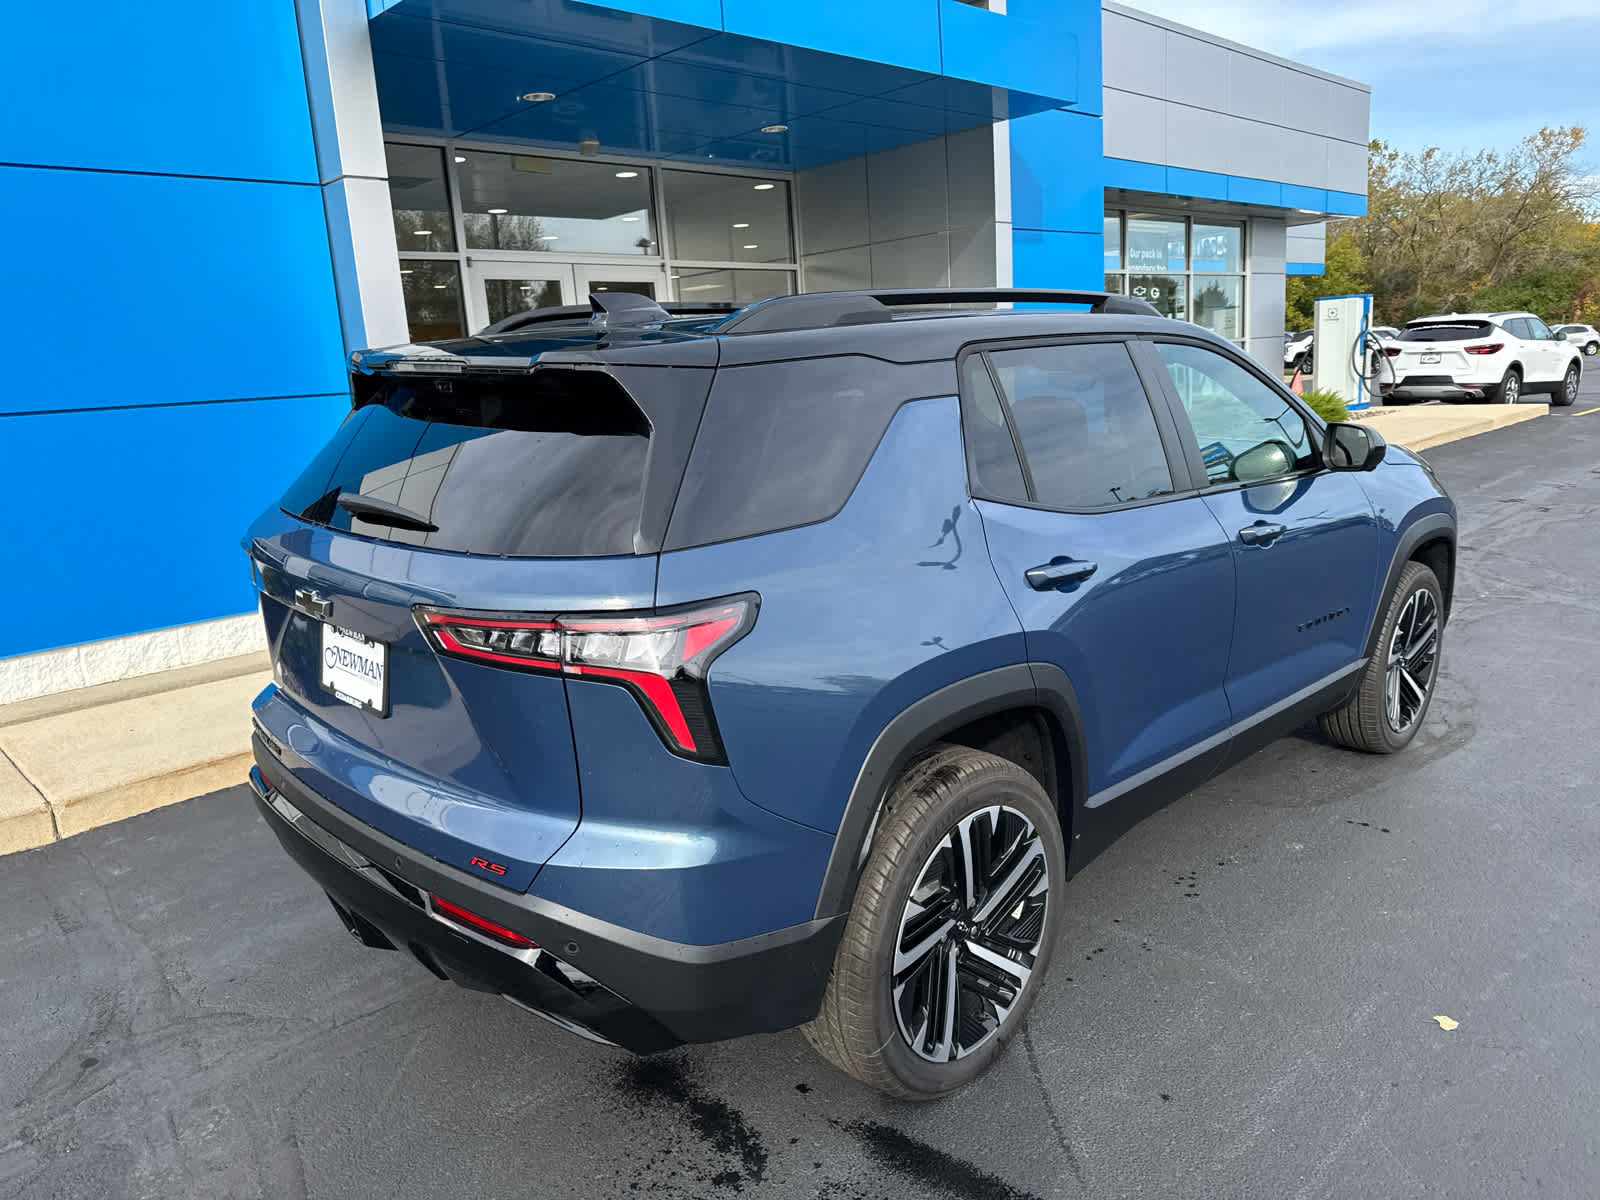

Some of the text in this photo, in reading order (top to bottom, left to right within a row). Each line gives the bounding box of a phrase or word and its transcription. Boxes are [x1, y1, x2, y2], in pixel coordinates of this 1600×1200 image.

[1150, 287, 1161, 299] G
[324, 645, 384, 681] NEWMAN
[470, 855, 507, 876] RS
